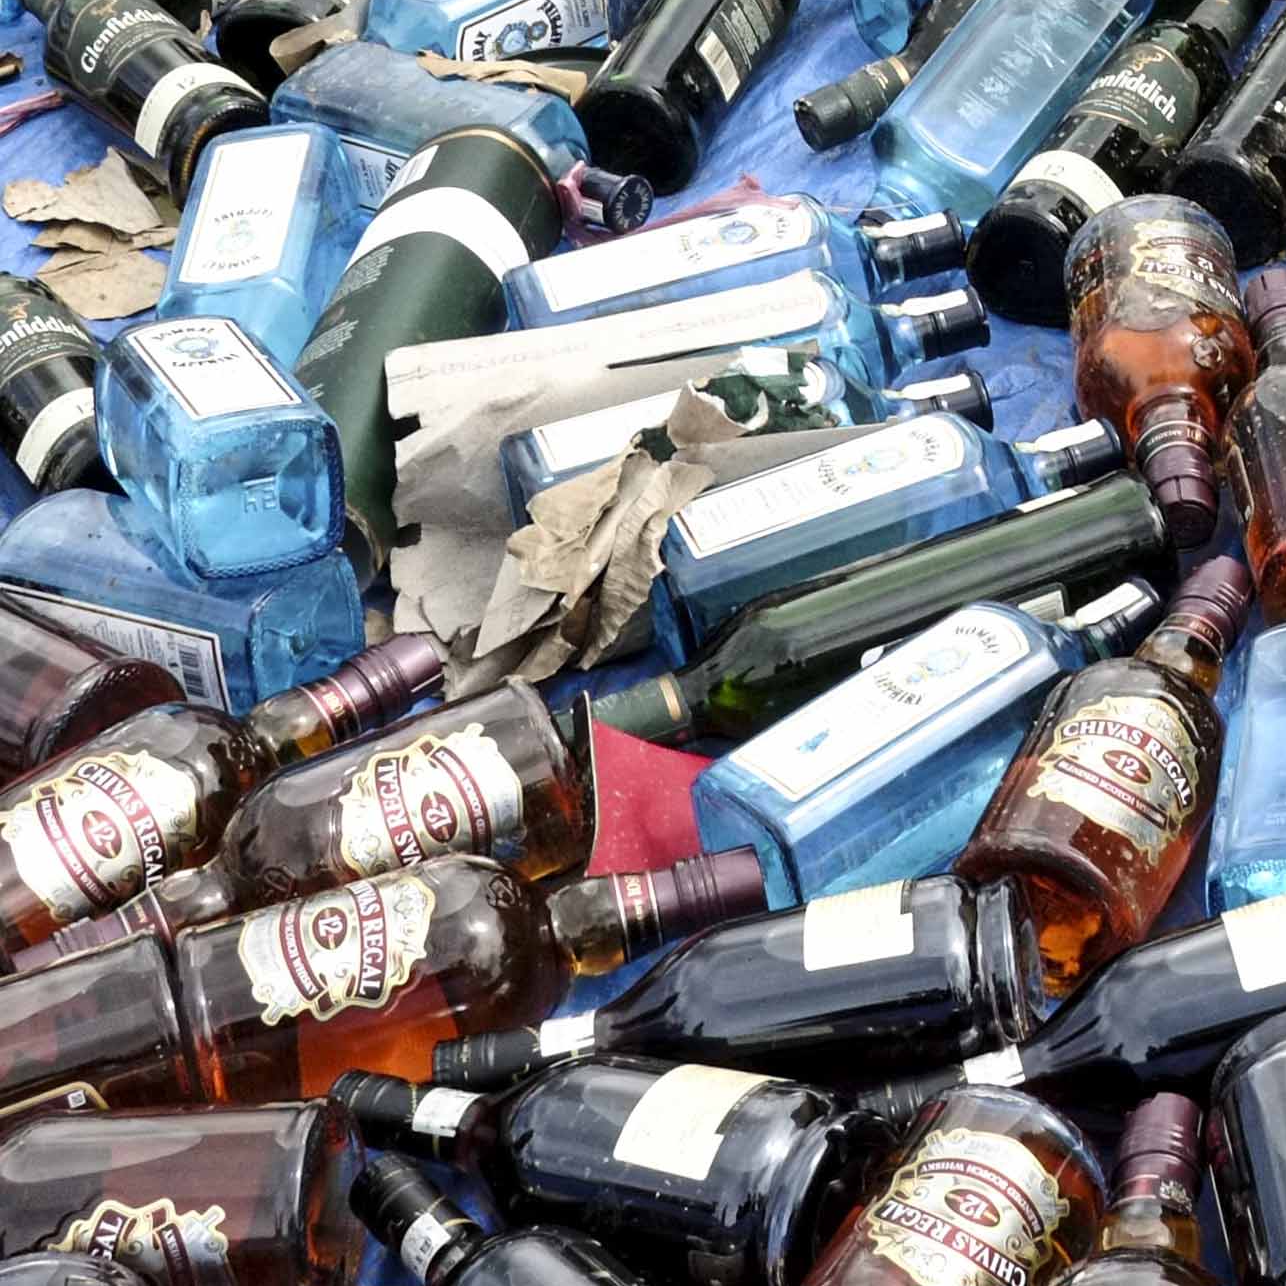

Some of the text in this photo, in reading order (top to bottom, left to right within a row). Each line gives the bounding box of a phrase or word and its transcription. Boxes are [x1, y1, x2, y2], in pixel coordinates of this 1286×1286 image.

[1087, 69, 1179, 120] enfiddich
[1062, 720, 1192, 806] CHIVAS REGAL
[1115, 753, 1141, 777] 12
[77, 762, 164, 888] CHIVAS REGAL
[377, 758, 428, 866] VAS REGAL
[425, 804, 449, 834] 12
[87, 822, 116, 851] 12
[317, 914, 344, 939] 12
[356, 916, 387, 998] REGAL
[958, 1194, 990, 1220] 12
[91, 1216, 124, 1262] GAL
[880, 1199, 1028, 1286] CHIVAS REGAL
